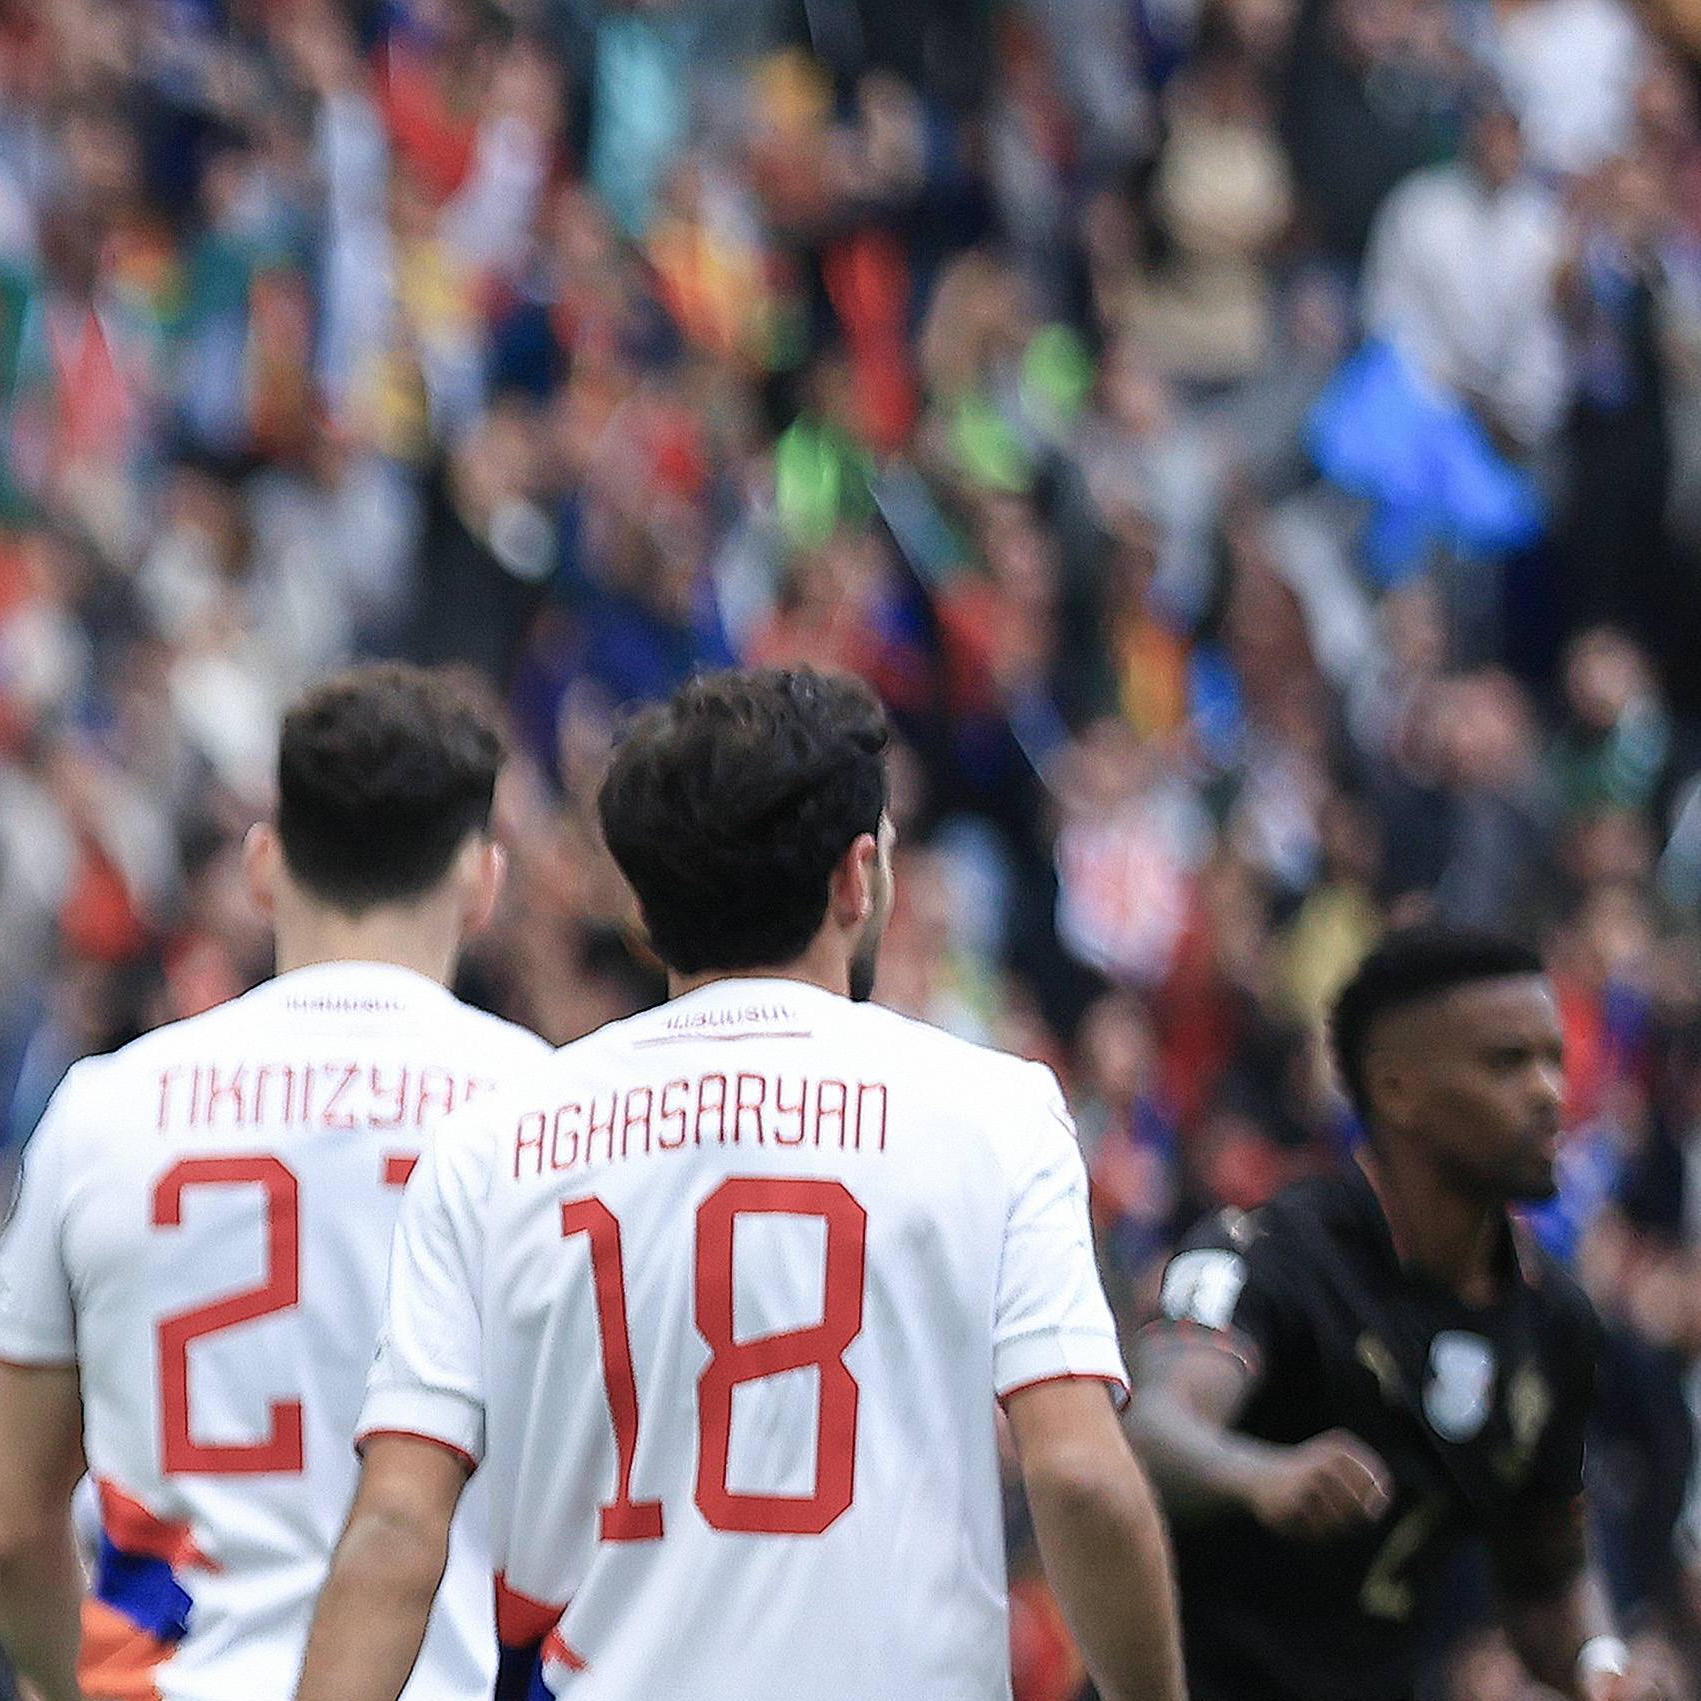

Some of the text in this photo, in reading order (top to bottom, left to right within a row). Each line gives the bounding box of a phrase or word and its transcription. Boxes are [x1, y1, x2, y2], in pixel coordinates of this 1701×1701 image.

[513, 1072, 890, 1181] AGHASARYAN
[151, 1156, 421, 1474] 2
[561, 1175, 867, 1541] 18
